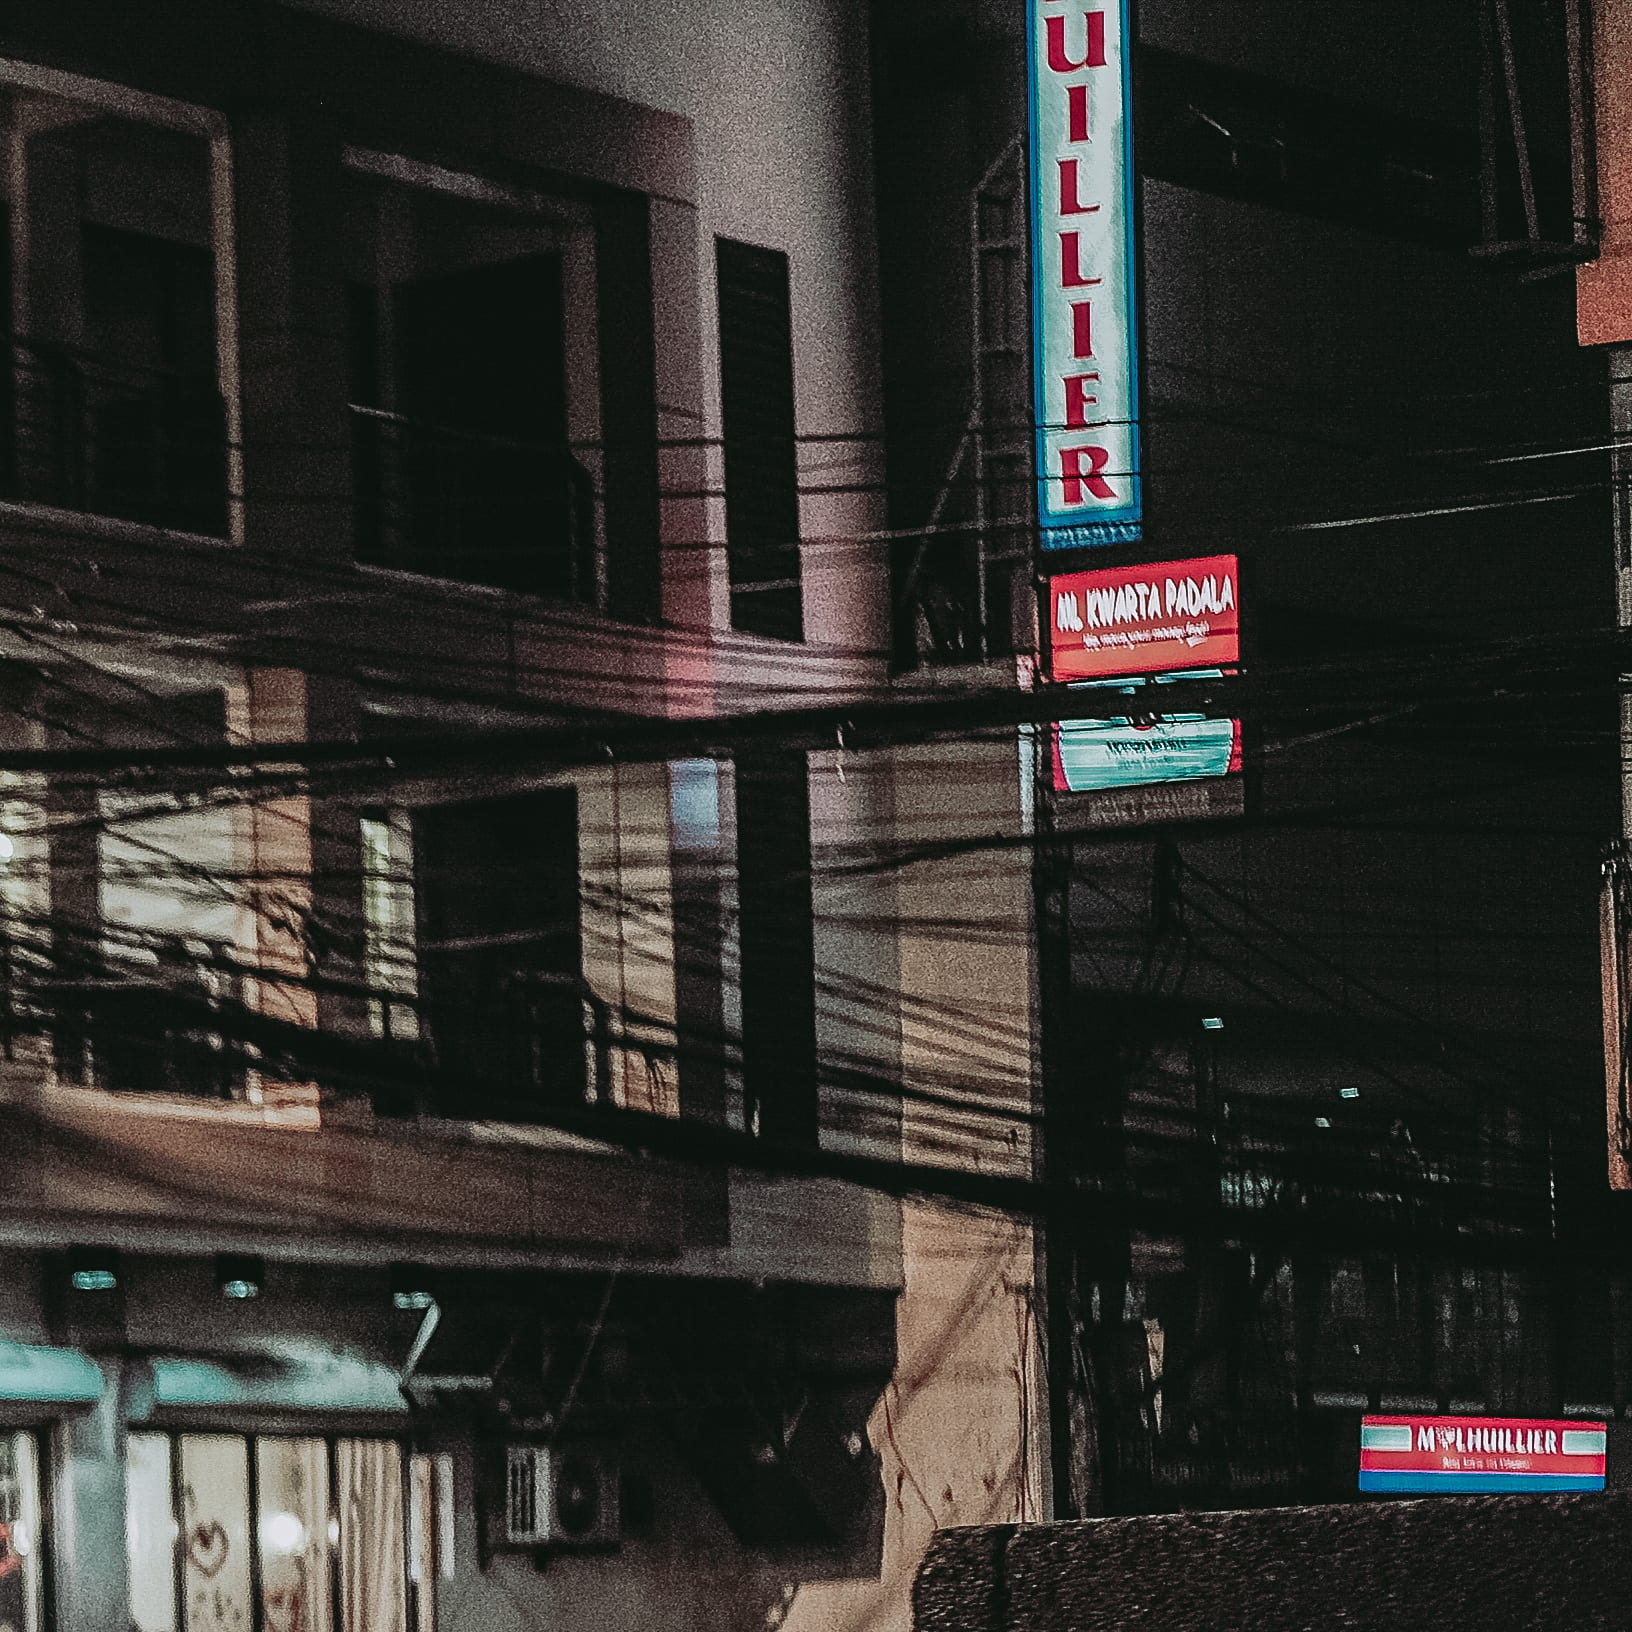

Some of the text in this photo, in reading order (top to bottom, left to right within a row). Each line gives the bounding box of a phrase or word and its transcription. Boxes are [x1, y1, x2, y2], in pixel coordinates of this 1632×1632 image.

[1044, 0, 1119, 506] UILLIER
[1086, 582, 1163, 630] KWARTA
[1165, 574, 1235, 617] PADALA
